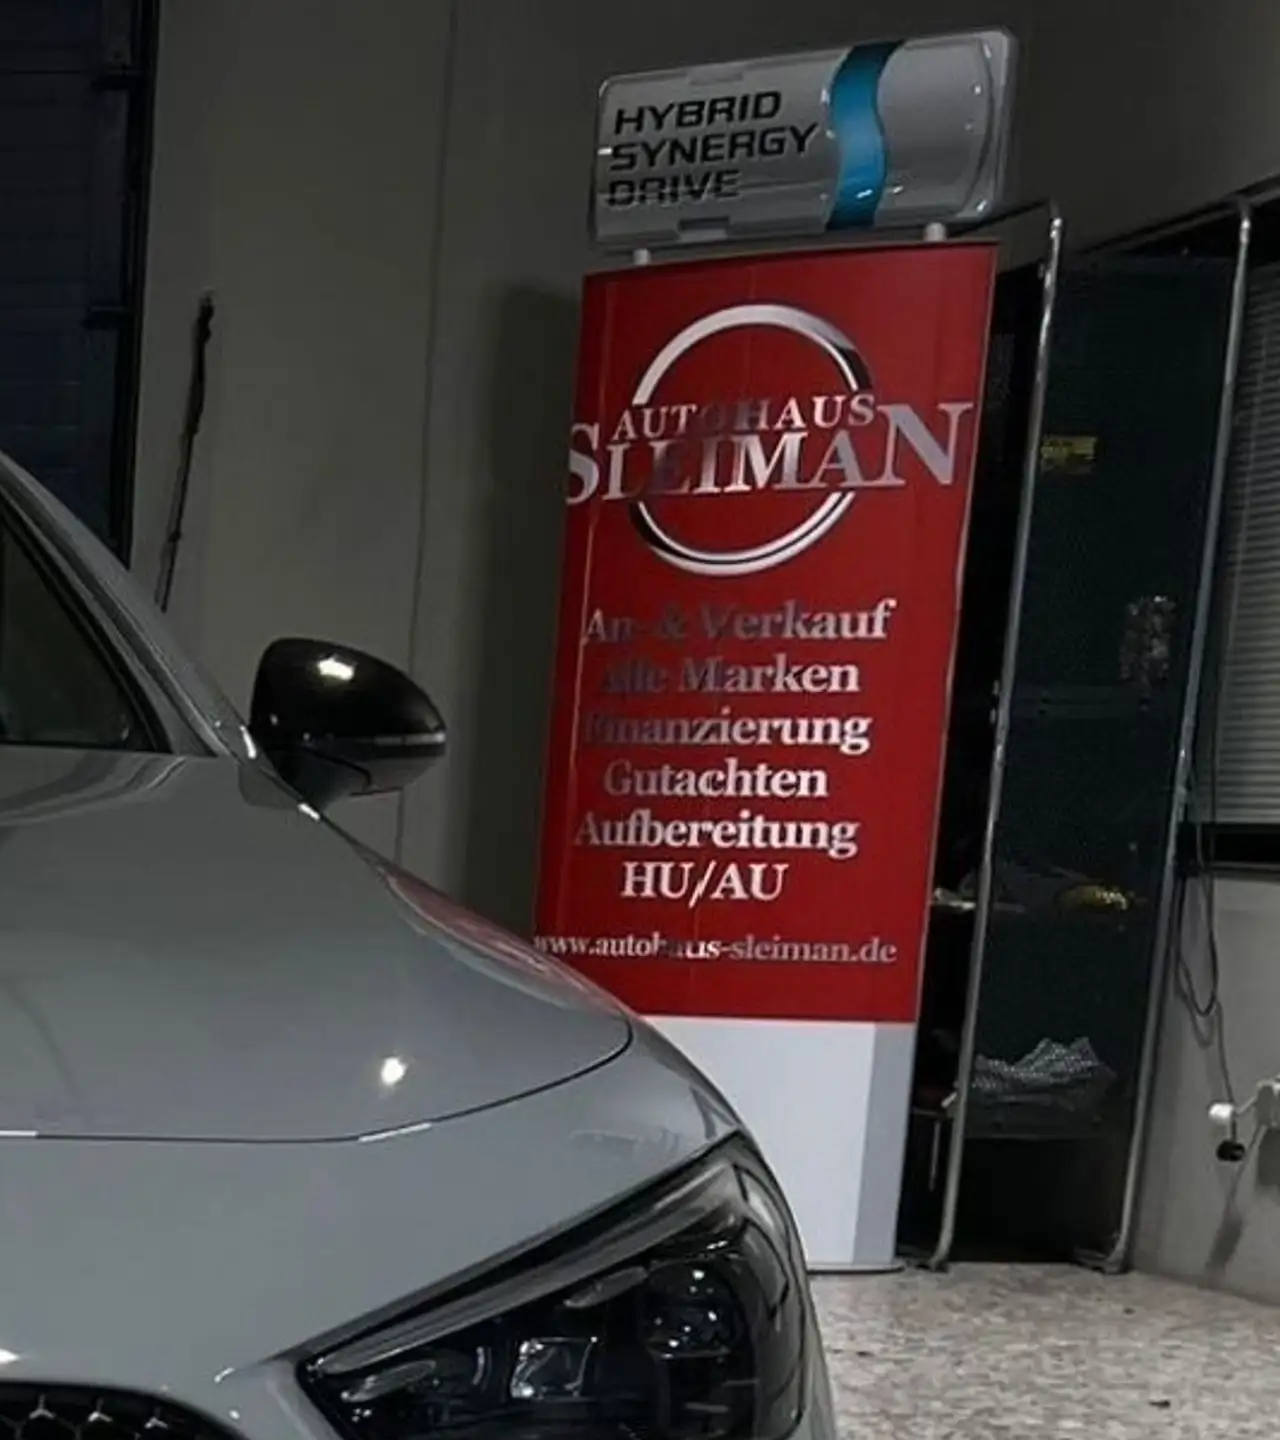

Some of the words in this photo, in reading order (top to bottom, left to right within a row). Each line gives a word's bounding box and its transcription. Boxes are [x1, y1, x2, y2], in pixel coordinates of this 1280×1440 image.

[613, 91, 782, 135] HYBRID
[609, 123, 818, 170] SYNERGY
[605, 169, 741, 207] DRIVE
[611, 393, 876, 443] AUTOHAUS
[699, 598, 897, 640] Verkauf
[677, 652, 861, 693] Marken
[584, 704, 873, 755] Finanzierung
[602, 757, 829, 798] Gutachten
[574, 808, 860, 858] Aufbereitung
[619, 861, 789, 908] HU/AU
